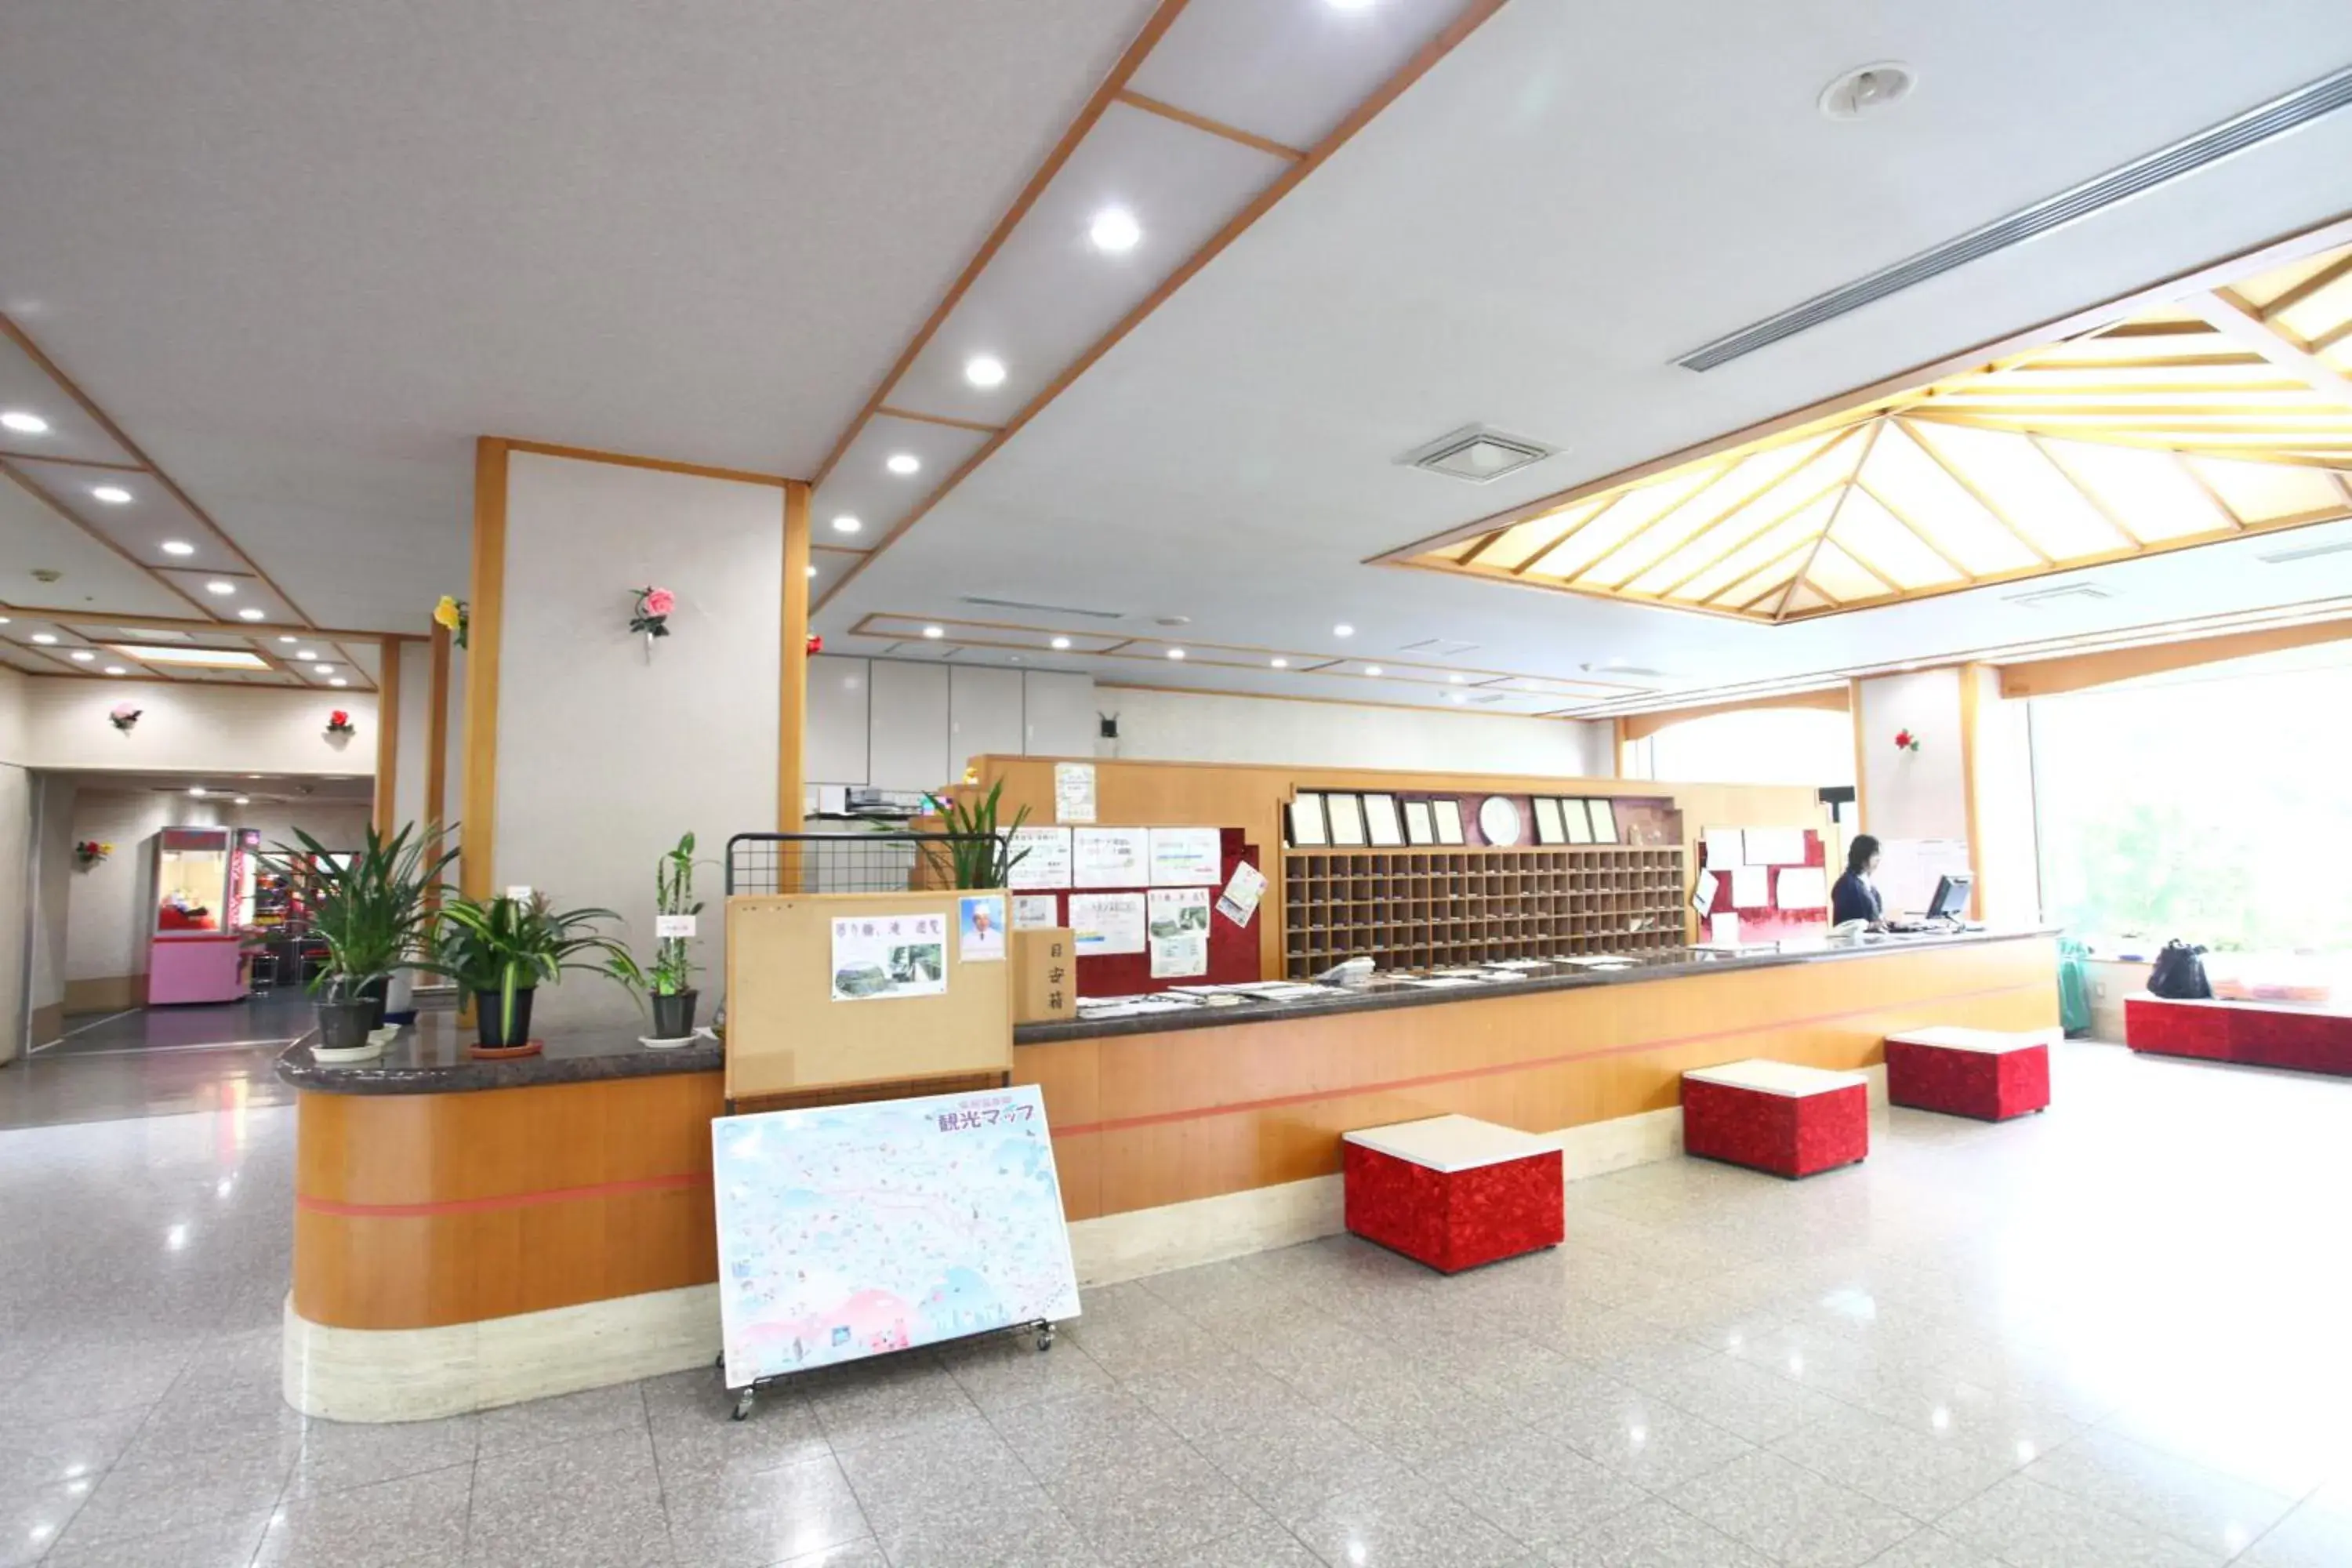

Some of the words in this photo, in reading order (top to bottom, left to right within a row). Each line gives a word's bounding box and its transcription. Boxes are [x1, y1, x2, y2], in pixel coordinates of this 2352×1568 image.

[938, 1105, 1034, 1132] 観光マップ
